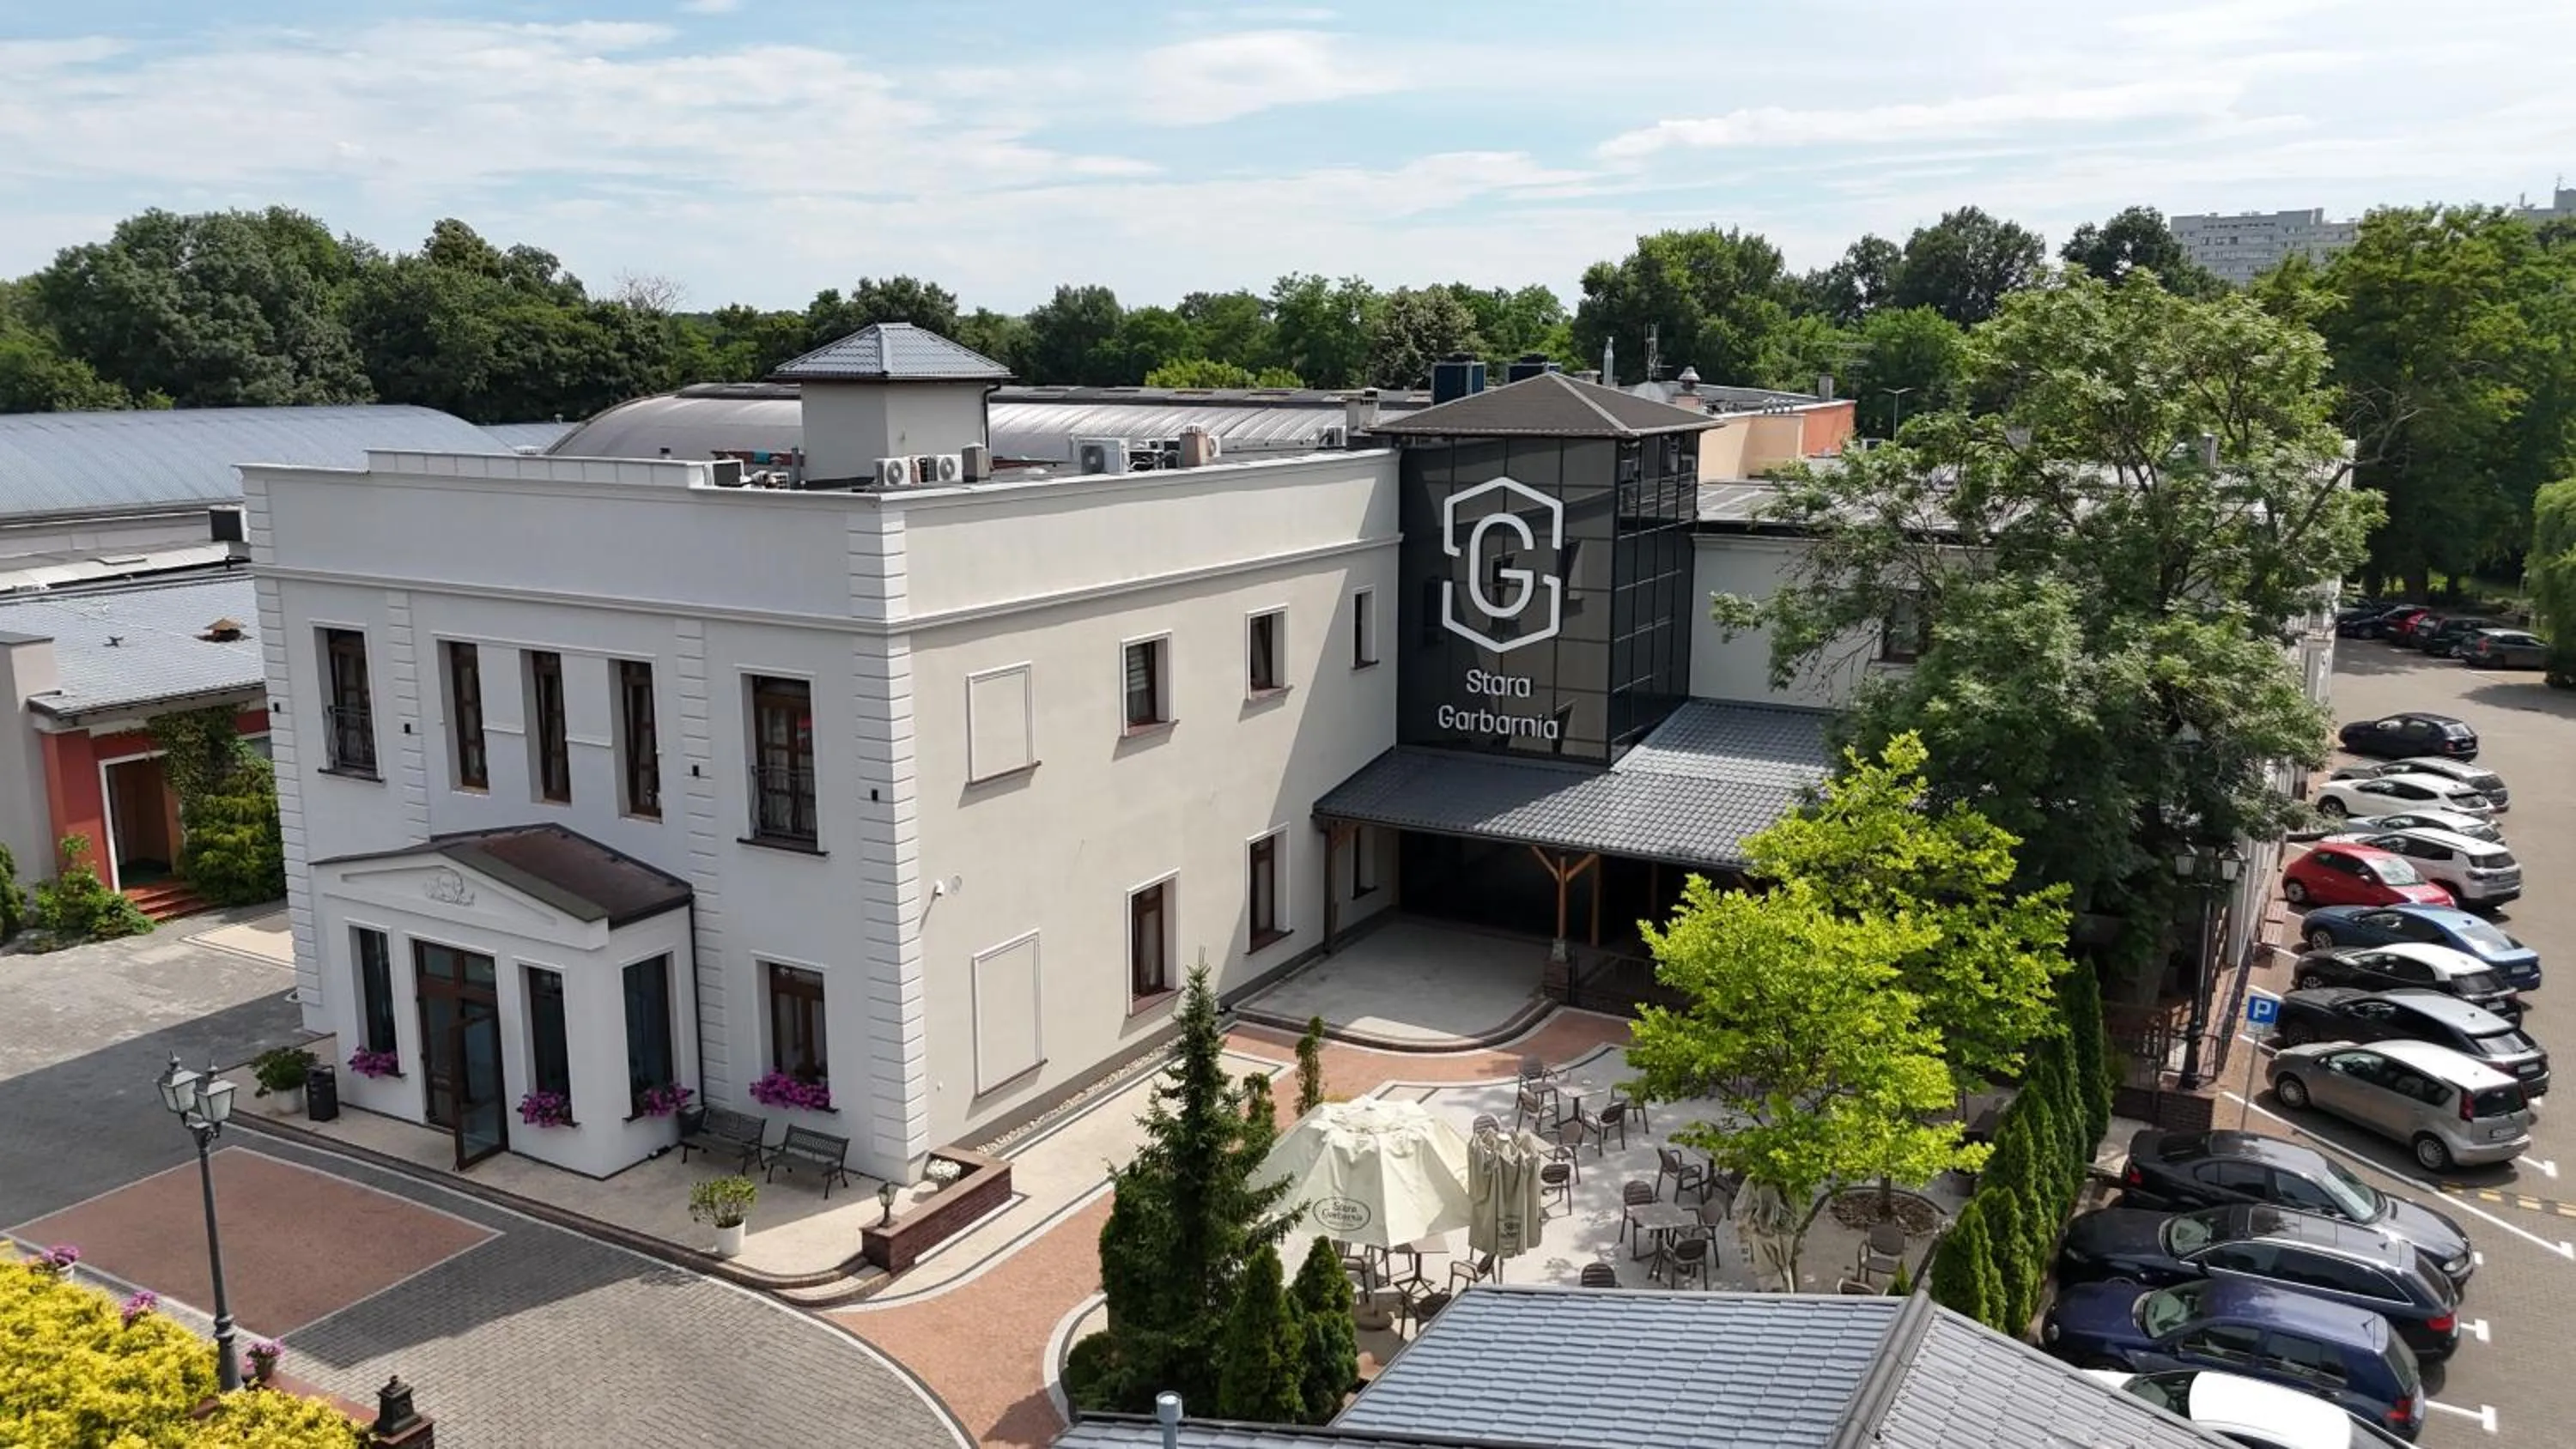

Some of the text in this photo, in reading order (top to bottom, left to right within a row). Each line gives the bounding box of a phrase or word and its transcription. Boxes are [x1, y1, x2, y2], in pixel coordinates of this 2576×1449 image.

[1469, 512, 1534, 618] G
[1466, 669, 1531, 698] Stara
[1437, 704, 1559, 740] Garbarnia
[2253, 999, 2271, 1019] P
